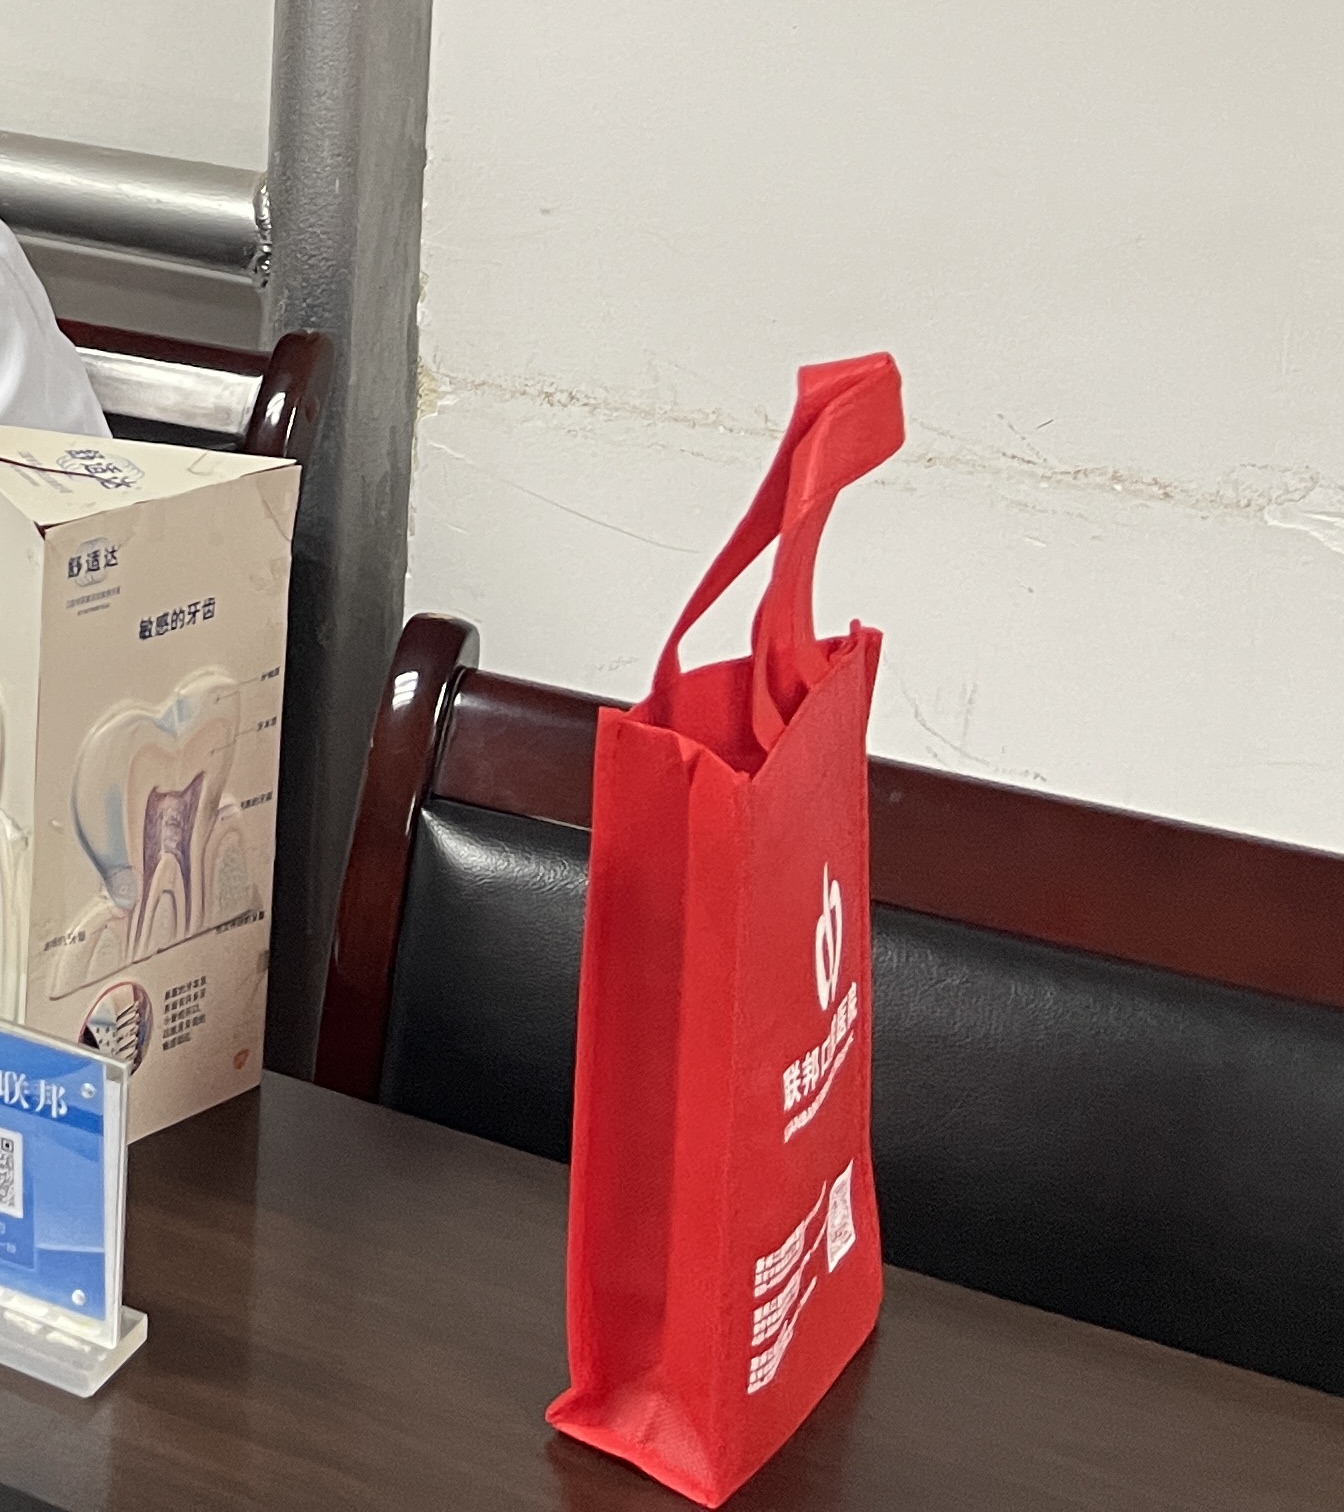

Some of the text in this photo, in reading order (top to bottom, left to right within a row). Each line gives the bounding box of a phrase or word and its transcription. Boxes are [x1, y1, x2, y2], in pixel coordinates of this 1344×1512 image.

[67, 545, 119, 579] 舒适达
[138, 597, 216, 641] 敏感的牙齿
